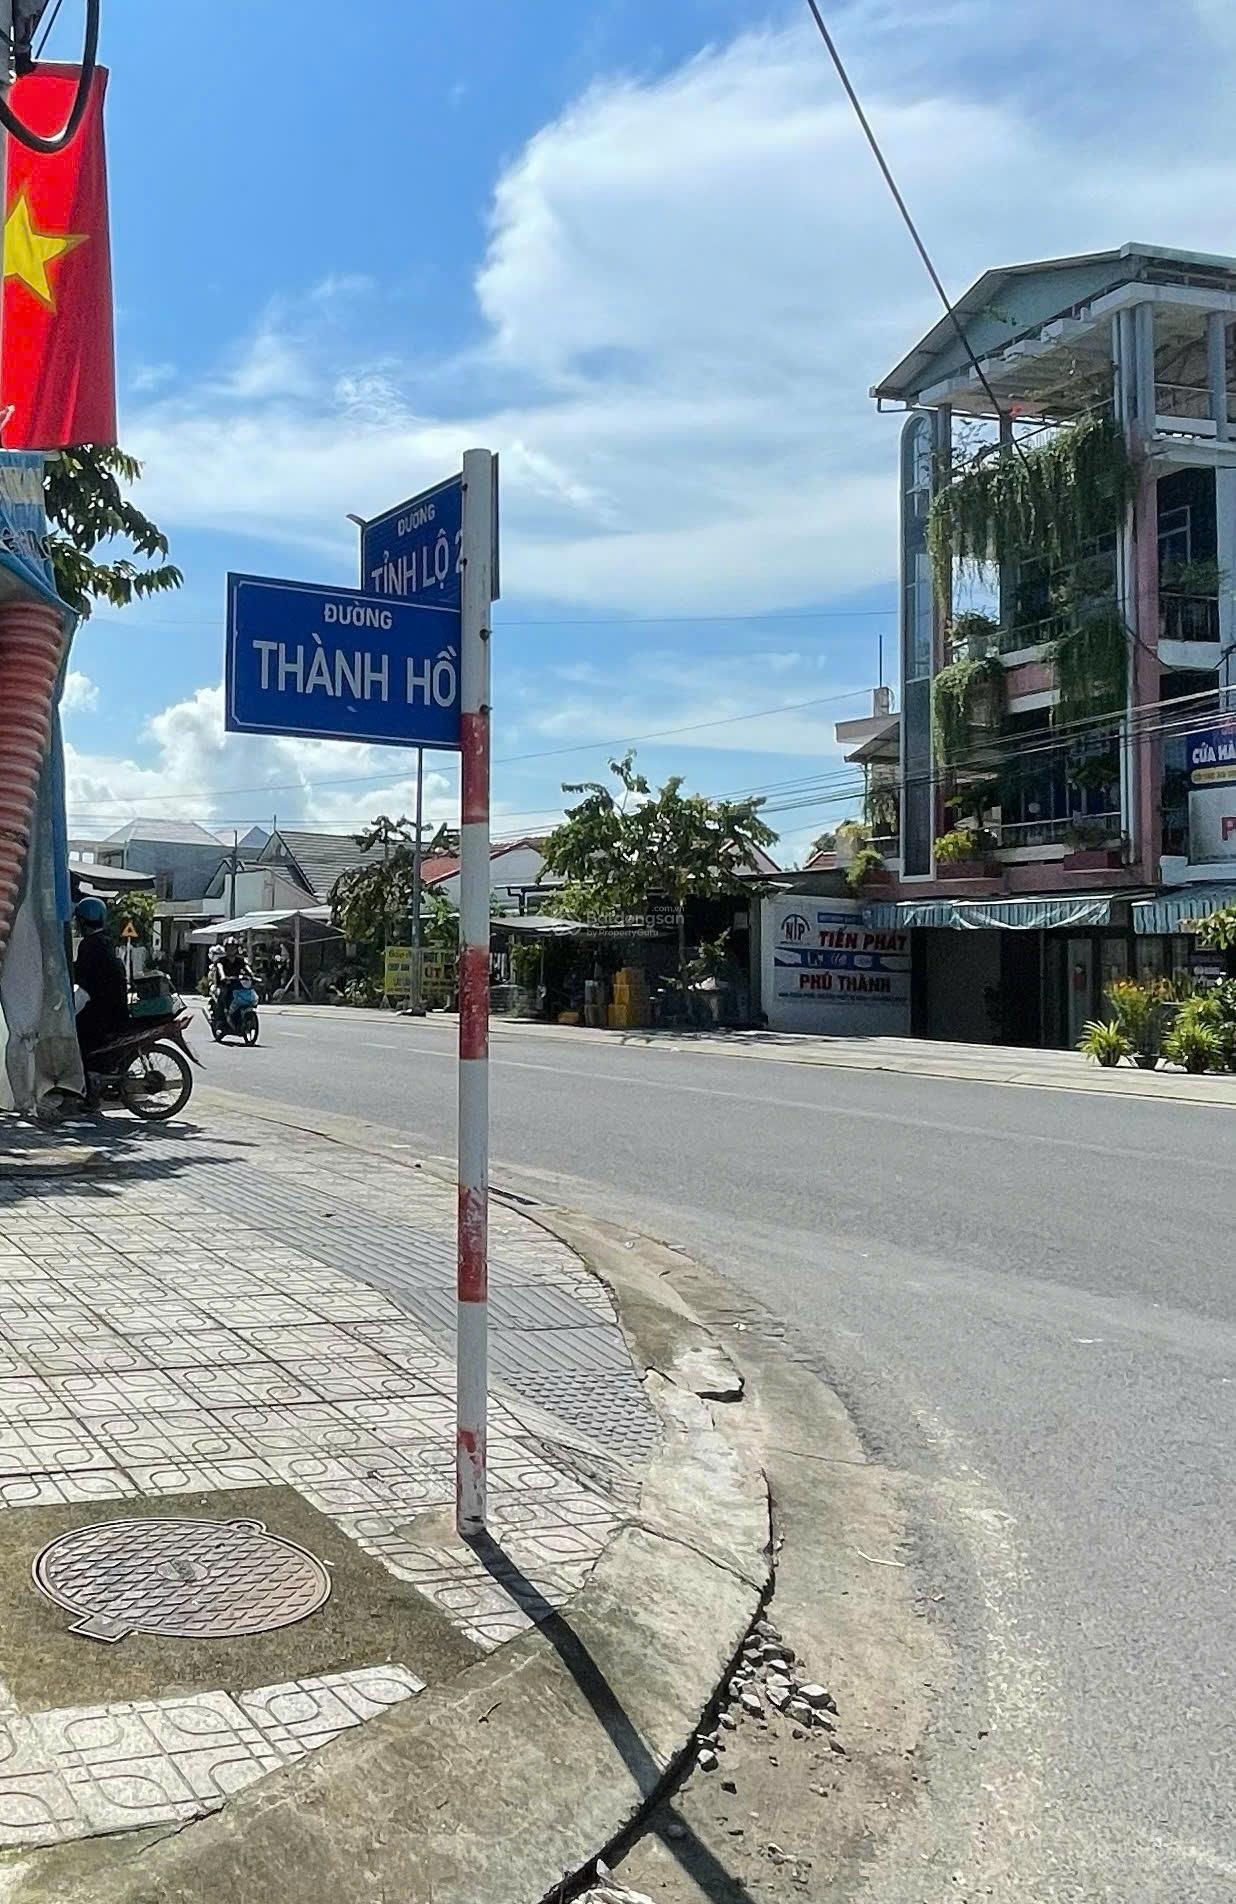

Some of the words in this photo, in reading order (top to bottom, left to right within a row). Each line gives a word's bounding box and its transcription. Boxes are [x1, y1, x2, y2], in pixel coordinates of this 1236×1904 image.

[371, 550, 417, 596] TỈNH
[422, 528, 449, 590] LỘ
[323, 601, 393, 630] ĐƯỜNG
[252, 632, 389, 702] THÀNH
[406, 645, 458, 708] HỒ
[799, 970, 833, 990] PHÚ
